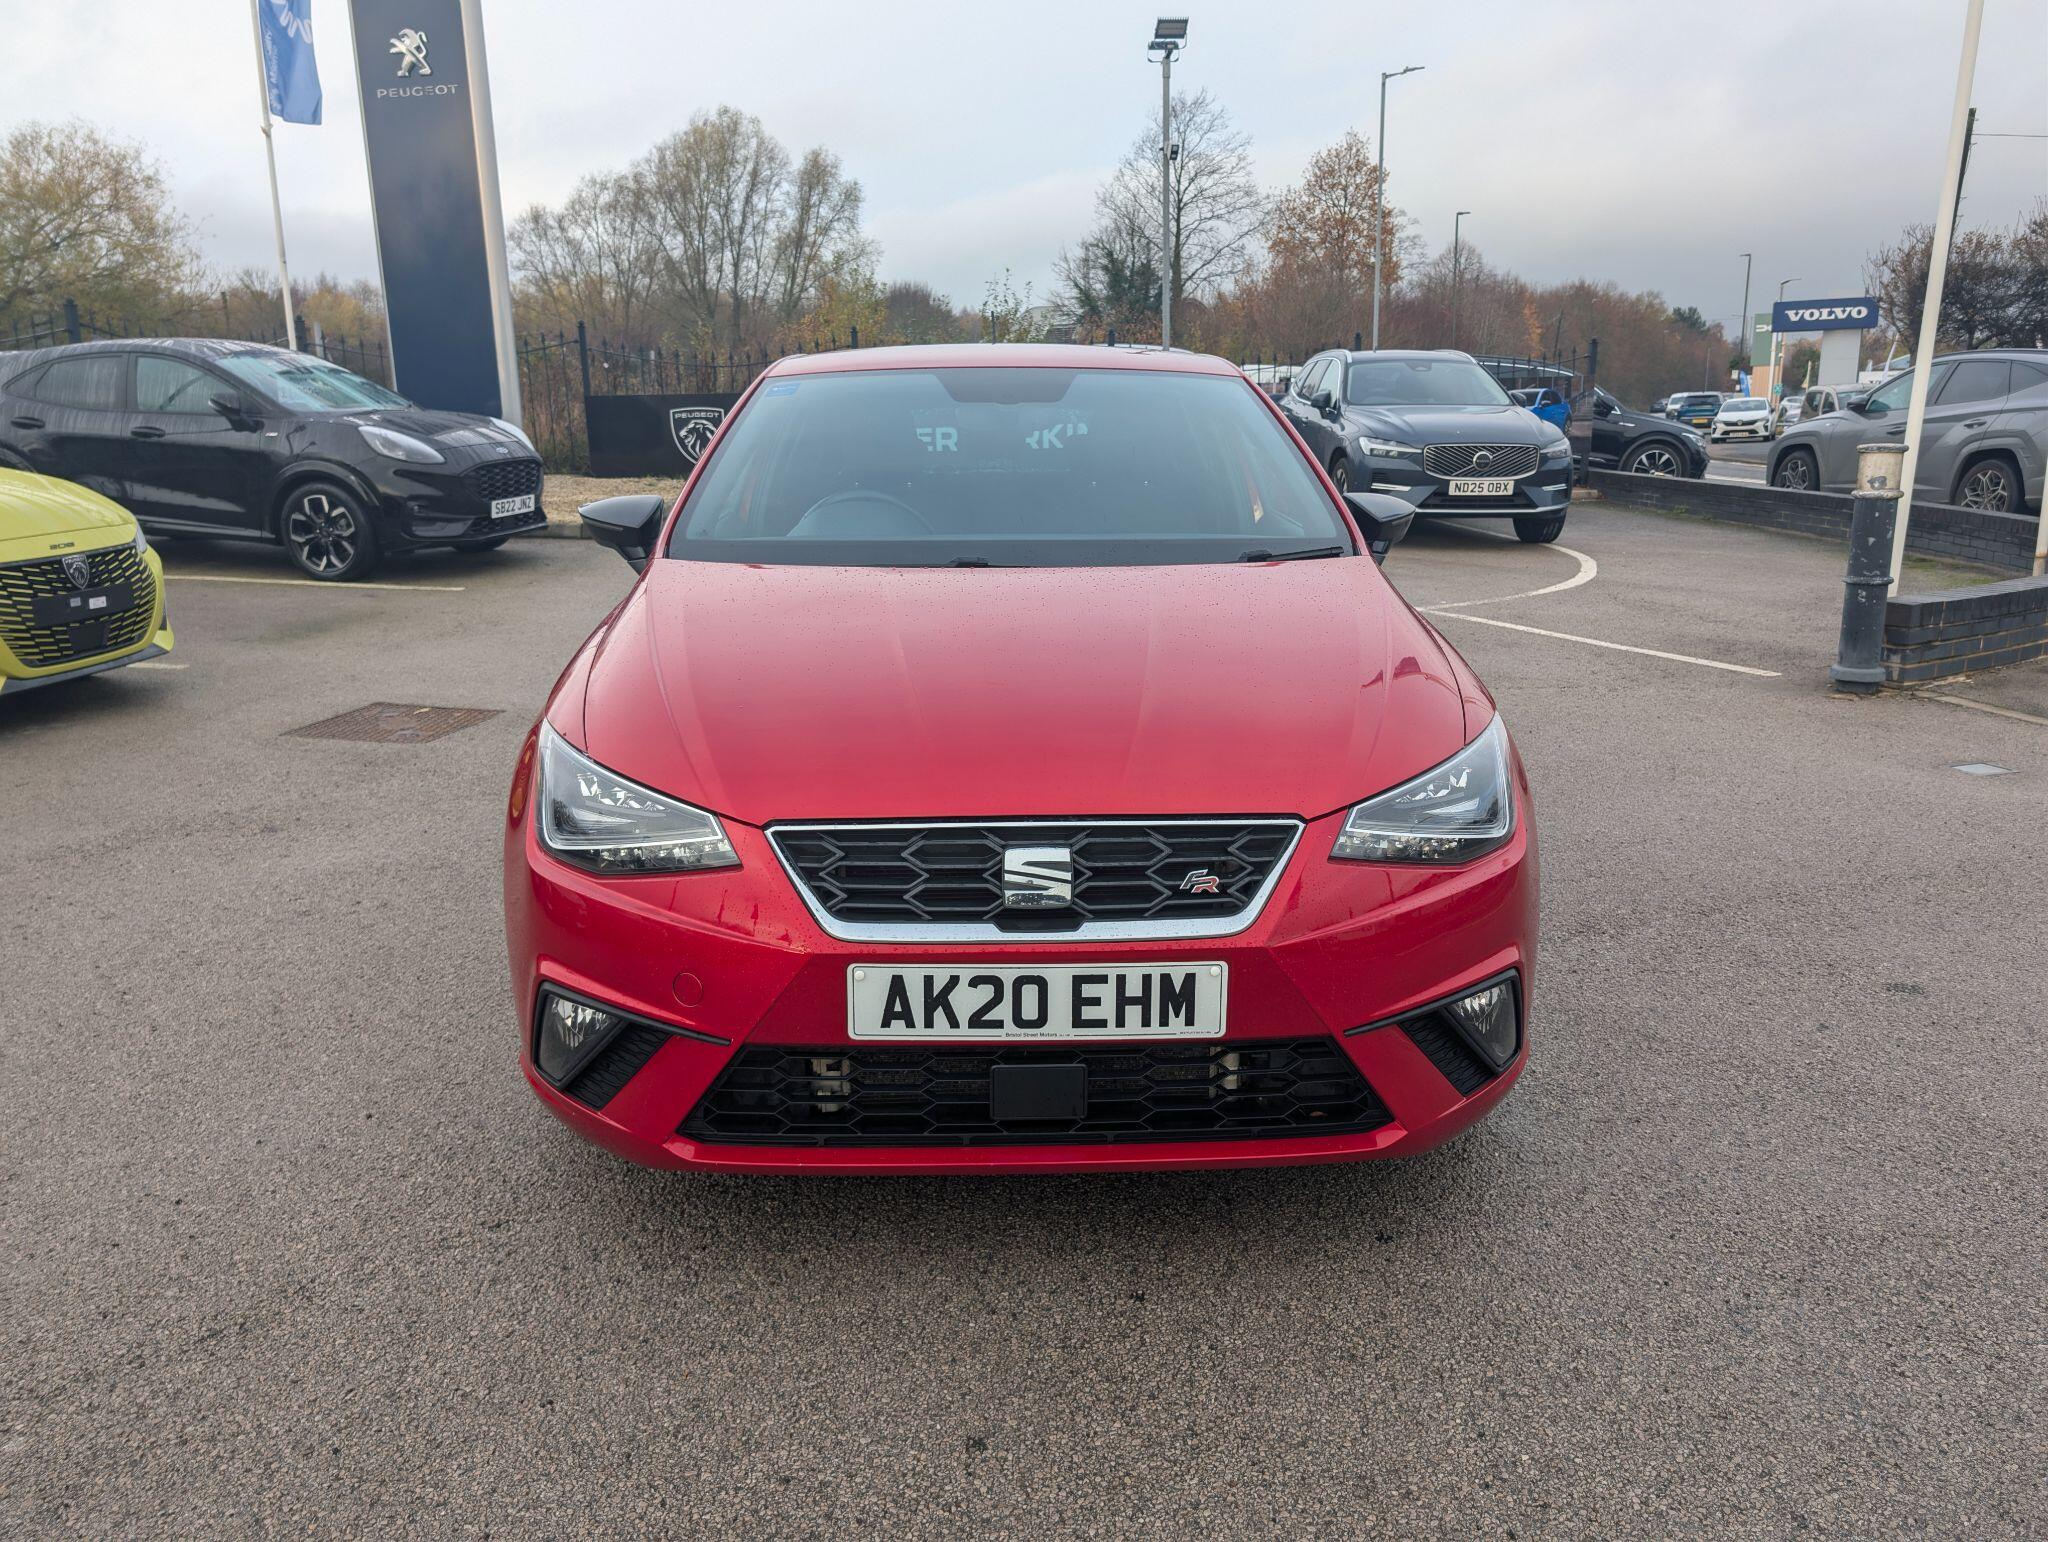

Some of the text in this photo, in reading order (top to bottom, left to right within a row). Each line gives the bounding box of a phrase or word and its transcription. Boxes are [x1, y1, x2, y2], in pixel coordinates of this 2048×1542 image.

[376, 85, 458, 98] PEUGEOT
[1785, 306, 1868, 321] VOLVO
[675, 411, 720, 419] PEUGEOT
[1454, 482, 1509, 493] ND25 OBX
[495, 497, 532, 515] SB22 JNZ
[1180, 869, 1219, 894] FR
[880, 973, 1197, 1029] AK20 EHM
